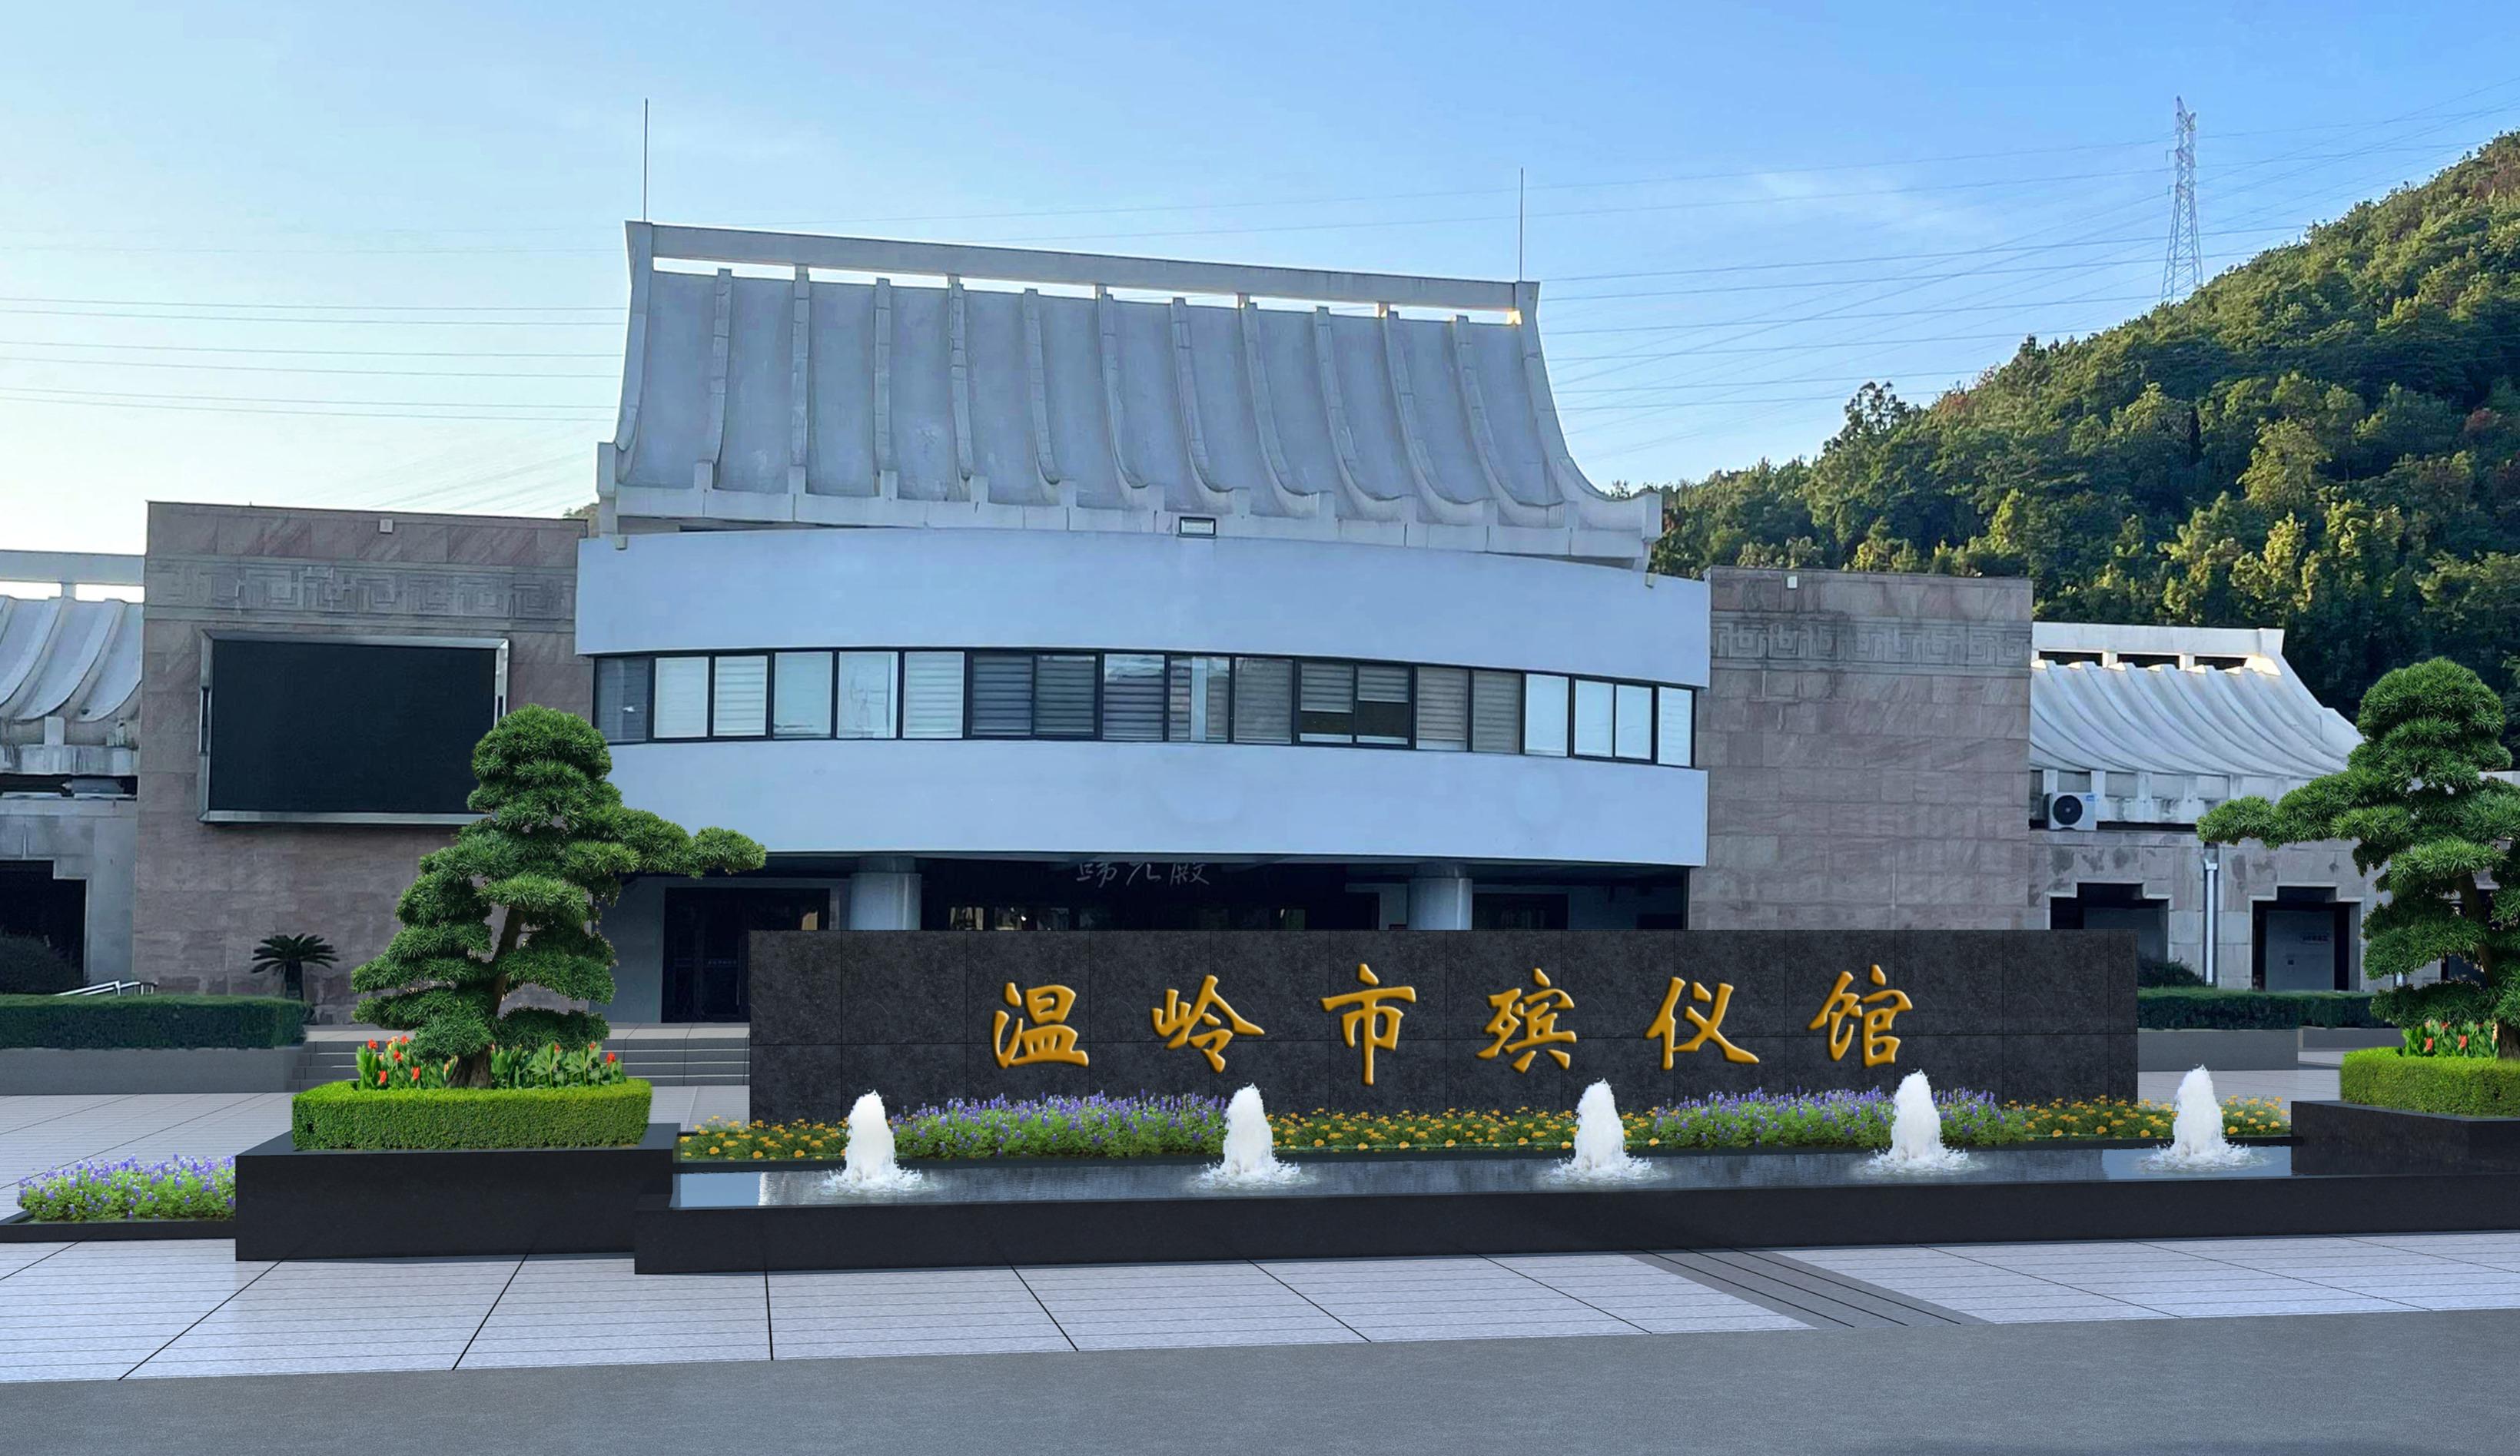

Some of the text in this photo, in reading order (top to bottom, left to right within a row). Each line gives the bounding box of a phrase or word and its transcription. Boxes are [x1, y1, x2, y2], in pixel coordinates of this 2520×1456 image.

[993, 963, 1914, 1086] 温岭市殡仪馆
